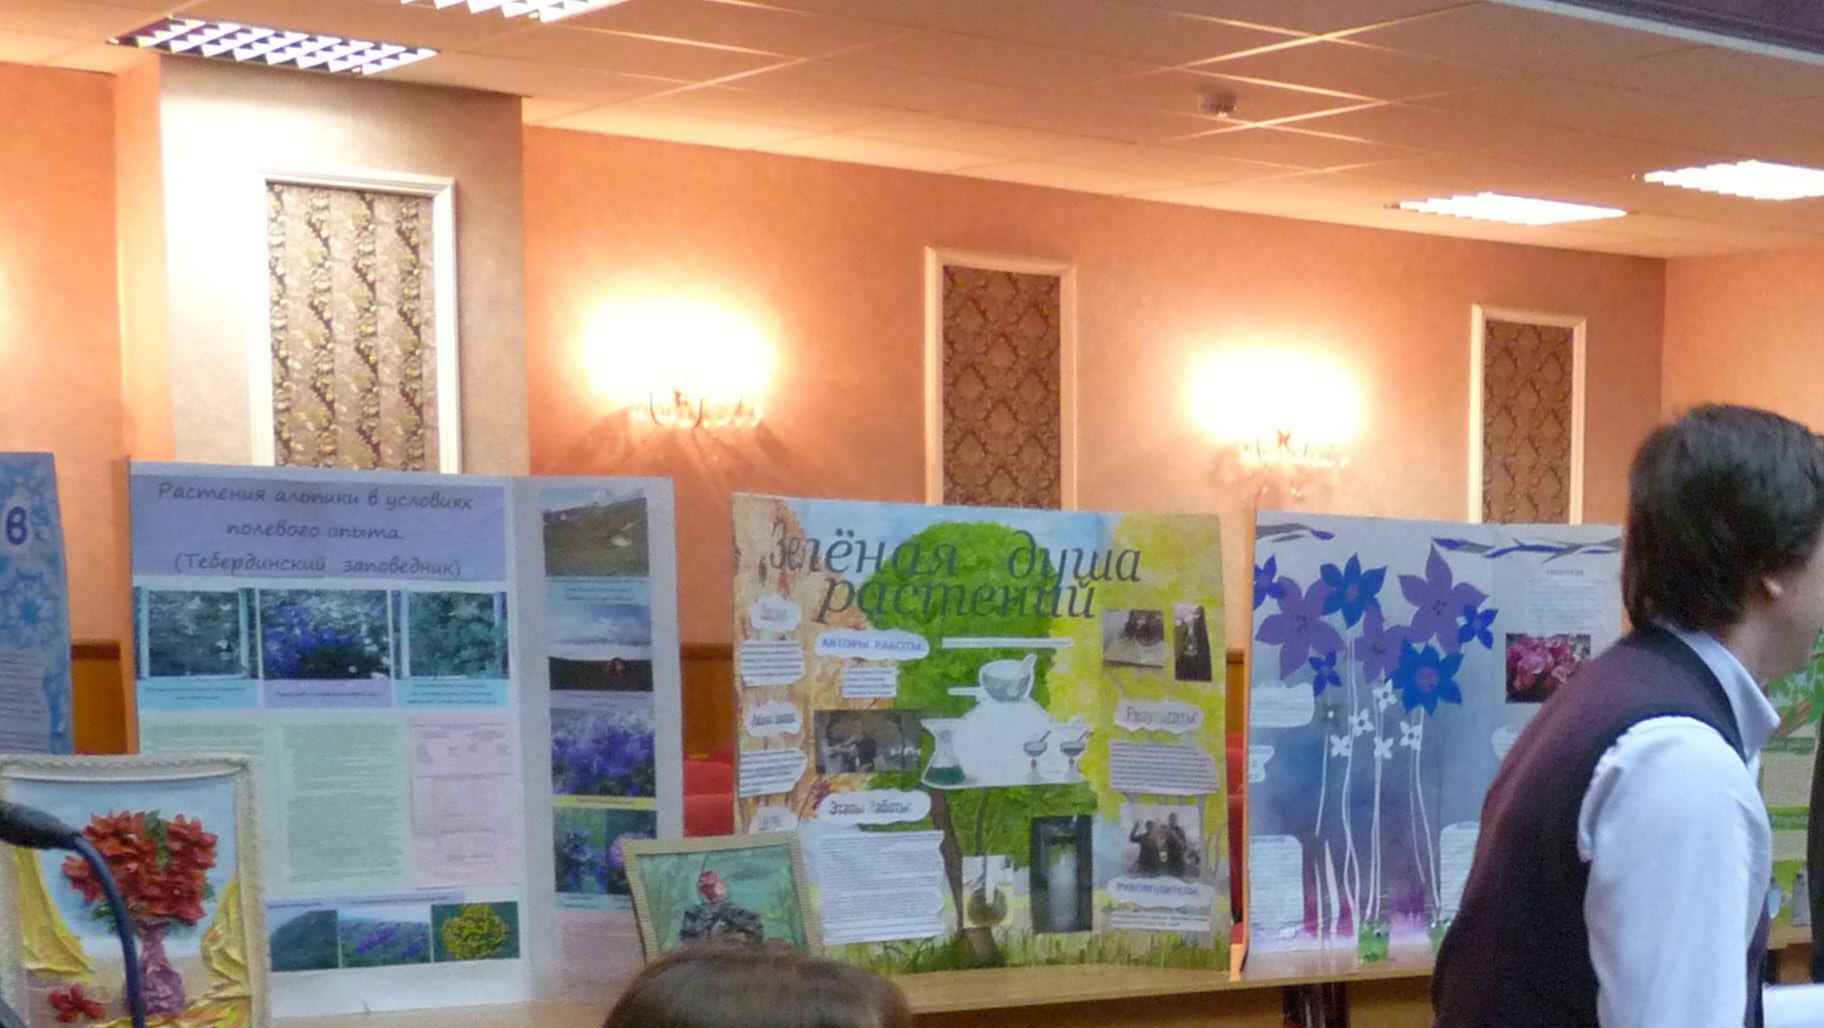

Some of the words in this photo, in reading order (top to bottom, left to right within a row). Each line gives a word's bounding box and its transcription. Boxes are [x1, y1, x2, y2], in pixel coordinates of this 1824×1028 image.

[158, 482, 266, 502] Растения
[367, 487, 379, 507] в
[386, 491, 474, 512] условиях
[226, 519, 320, 538] полевого
[768, 518, 958, 577] Зелёная
[1007, 528, 1141, 586] душа
[813, 573, 1096, 623] растений
